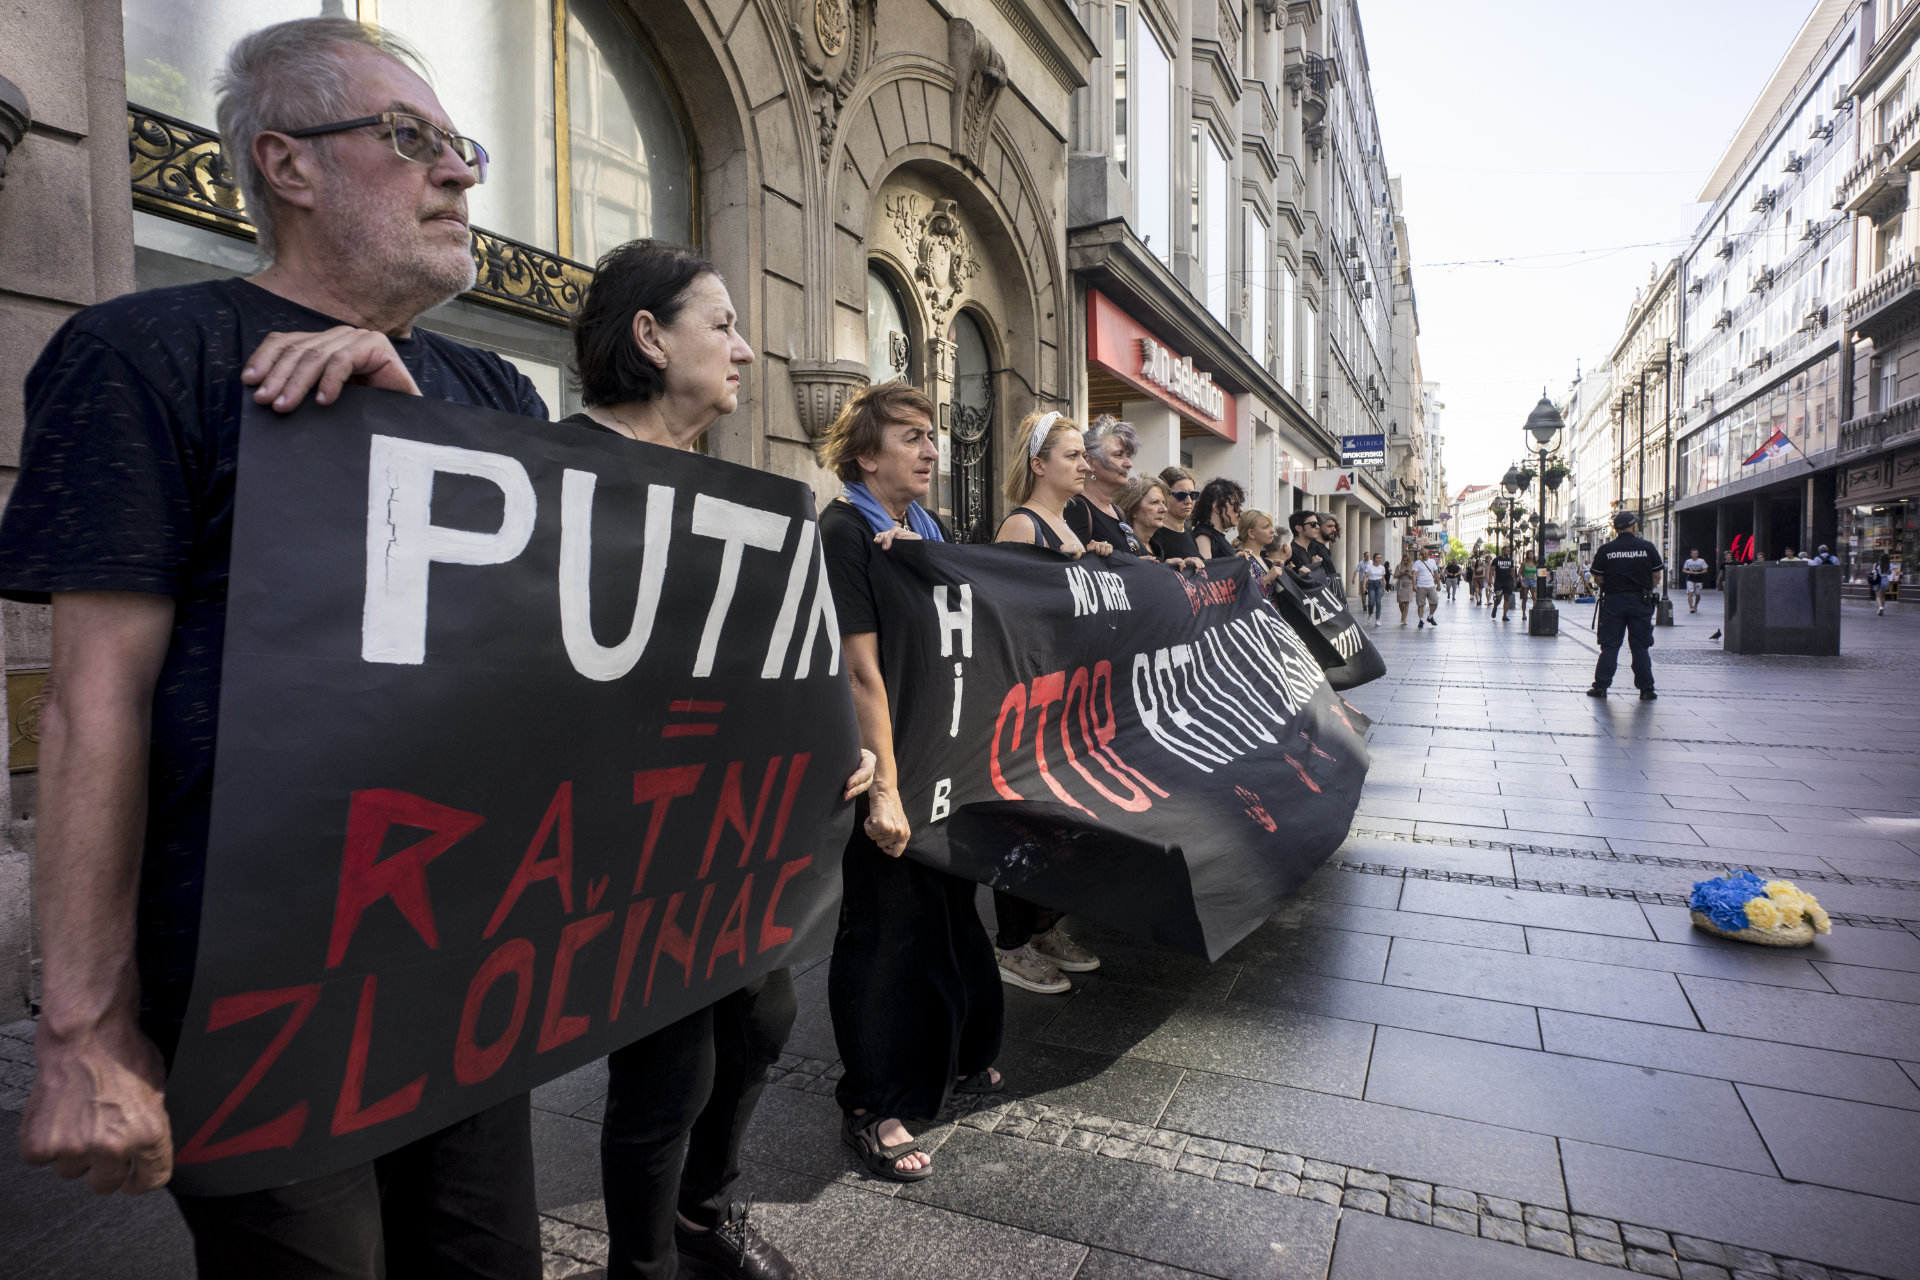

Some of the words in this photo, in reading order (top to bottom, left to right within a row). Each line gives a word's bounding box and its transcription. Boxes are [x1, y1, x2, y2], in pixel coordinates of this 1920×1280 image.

[1342, 450, 1384, 459] BROKERSKO
[1336, 472, 1354, 491] A1
[1606, 550, 1648, 559] ПОЛИЦИЈА
[1065, 565, 1098, 617] NO
[1093, 571, 1132, 611] WAR
[1321, 587, 1344, 612] U
[326, 753, 812, 968] RATNI
[174, 856, 812, 1165] ZLOČINAC
